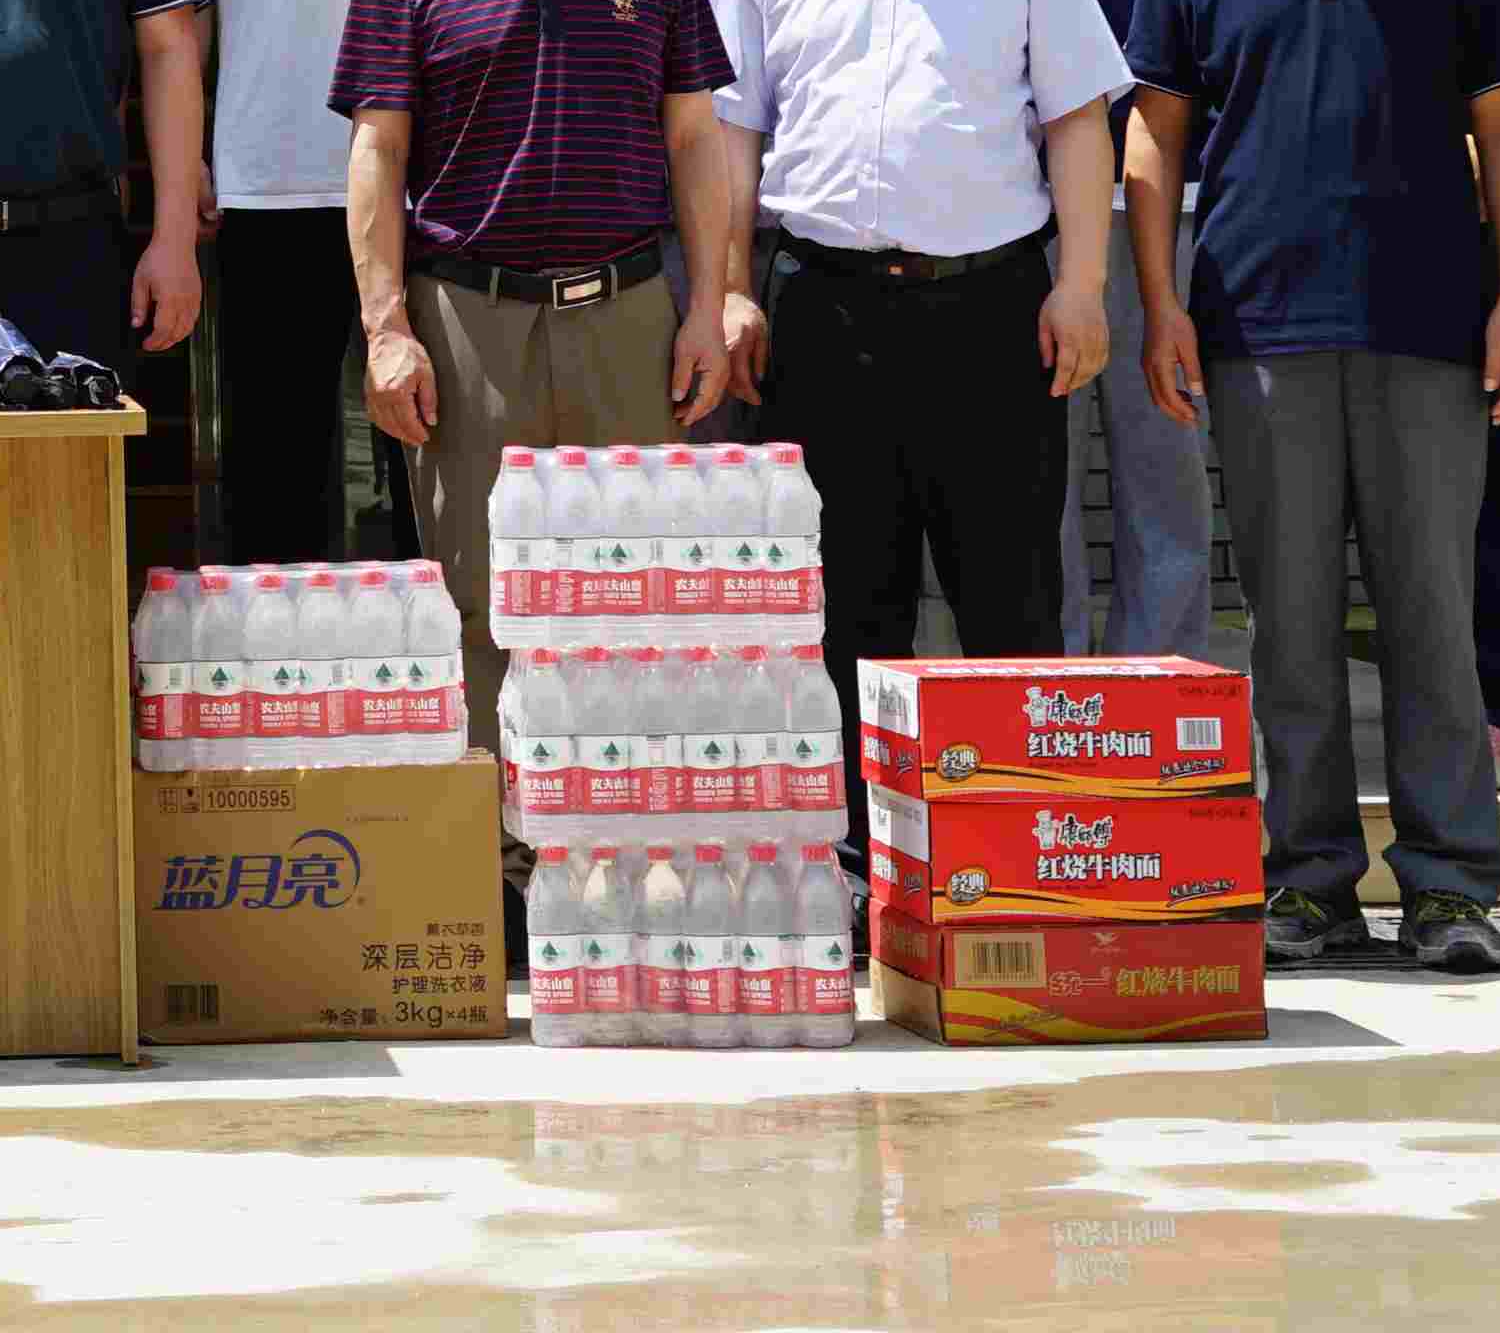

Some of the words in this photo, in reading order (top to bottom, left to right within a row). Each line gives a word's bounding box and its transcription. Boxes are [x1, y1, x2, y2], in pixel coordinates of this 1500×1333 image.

[1027, 731, 1152, 758] 红烧牛肉面
[206, 789, 292, 810] 10000595
[152, 850, 350, 911] 蓝月亮
[1036, 852, 1161, 881] 红烧牛肉面
[361, 942, 486, 973] 深层洁净
[391, 974, 488, 995] 护理洗衣液
[1115, 965, 1240, 997] 红烧牛肉面
